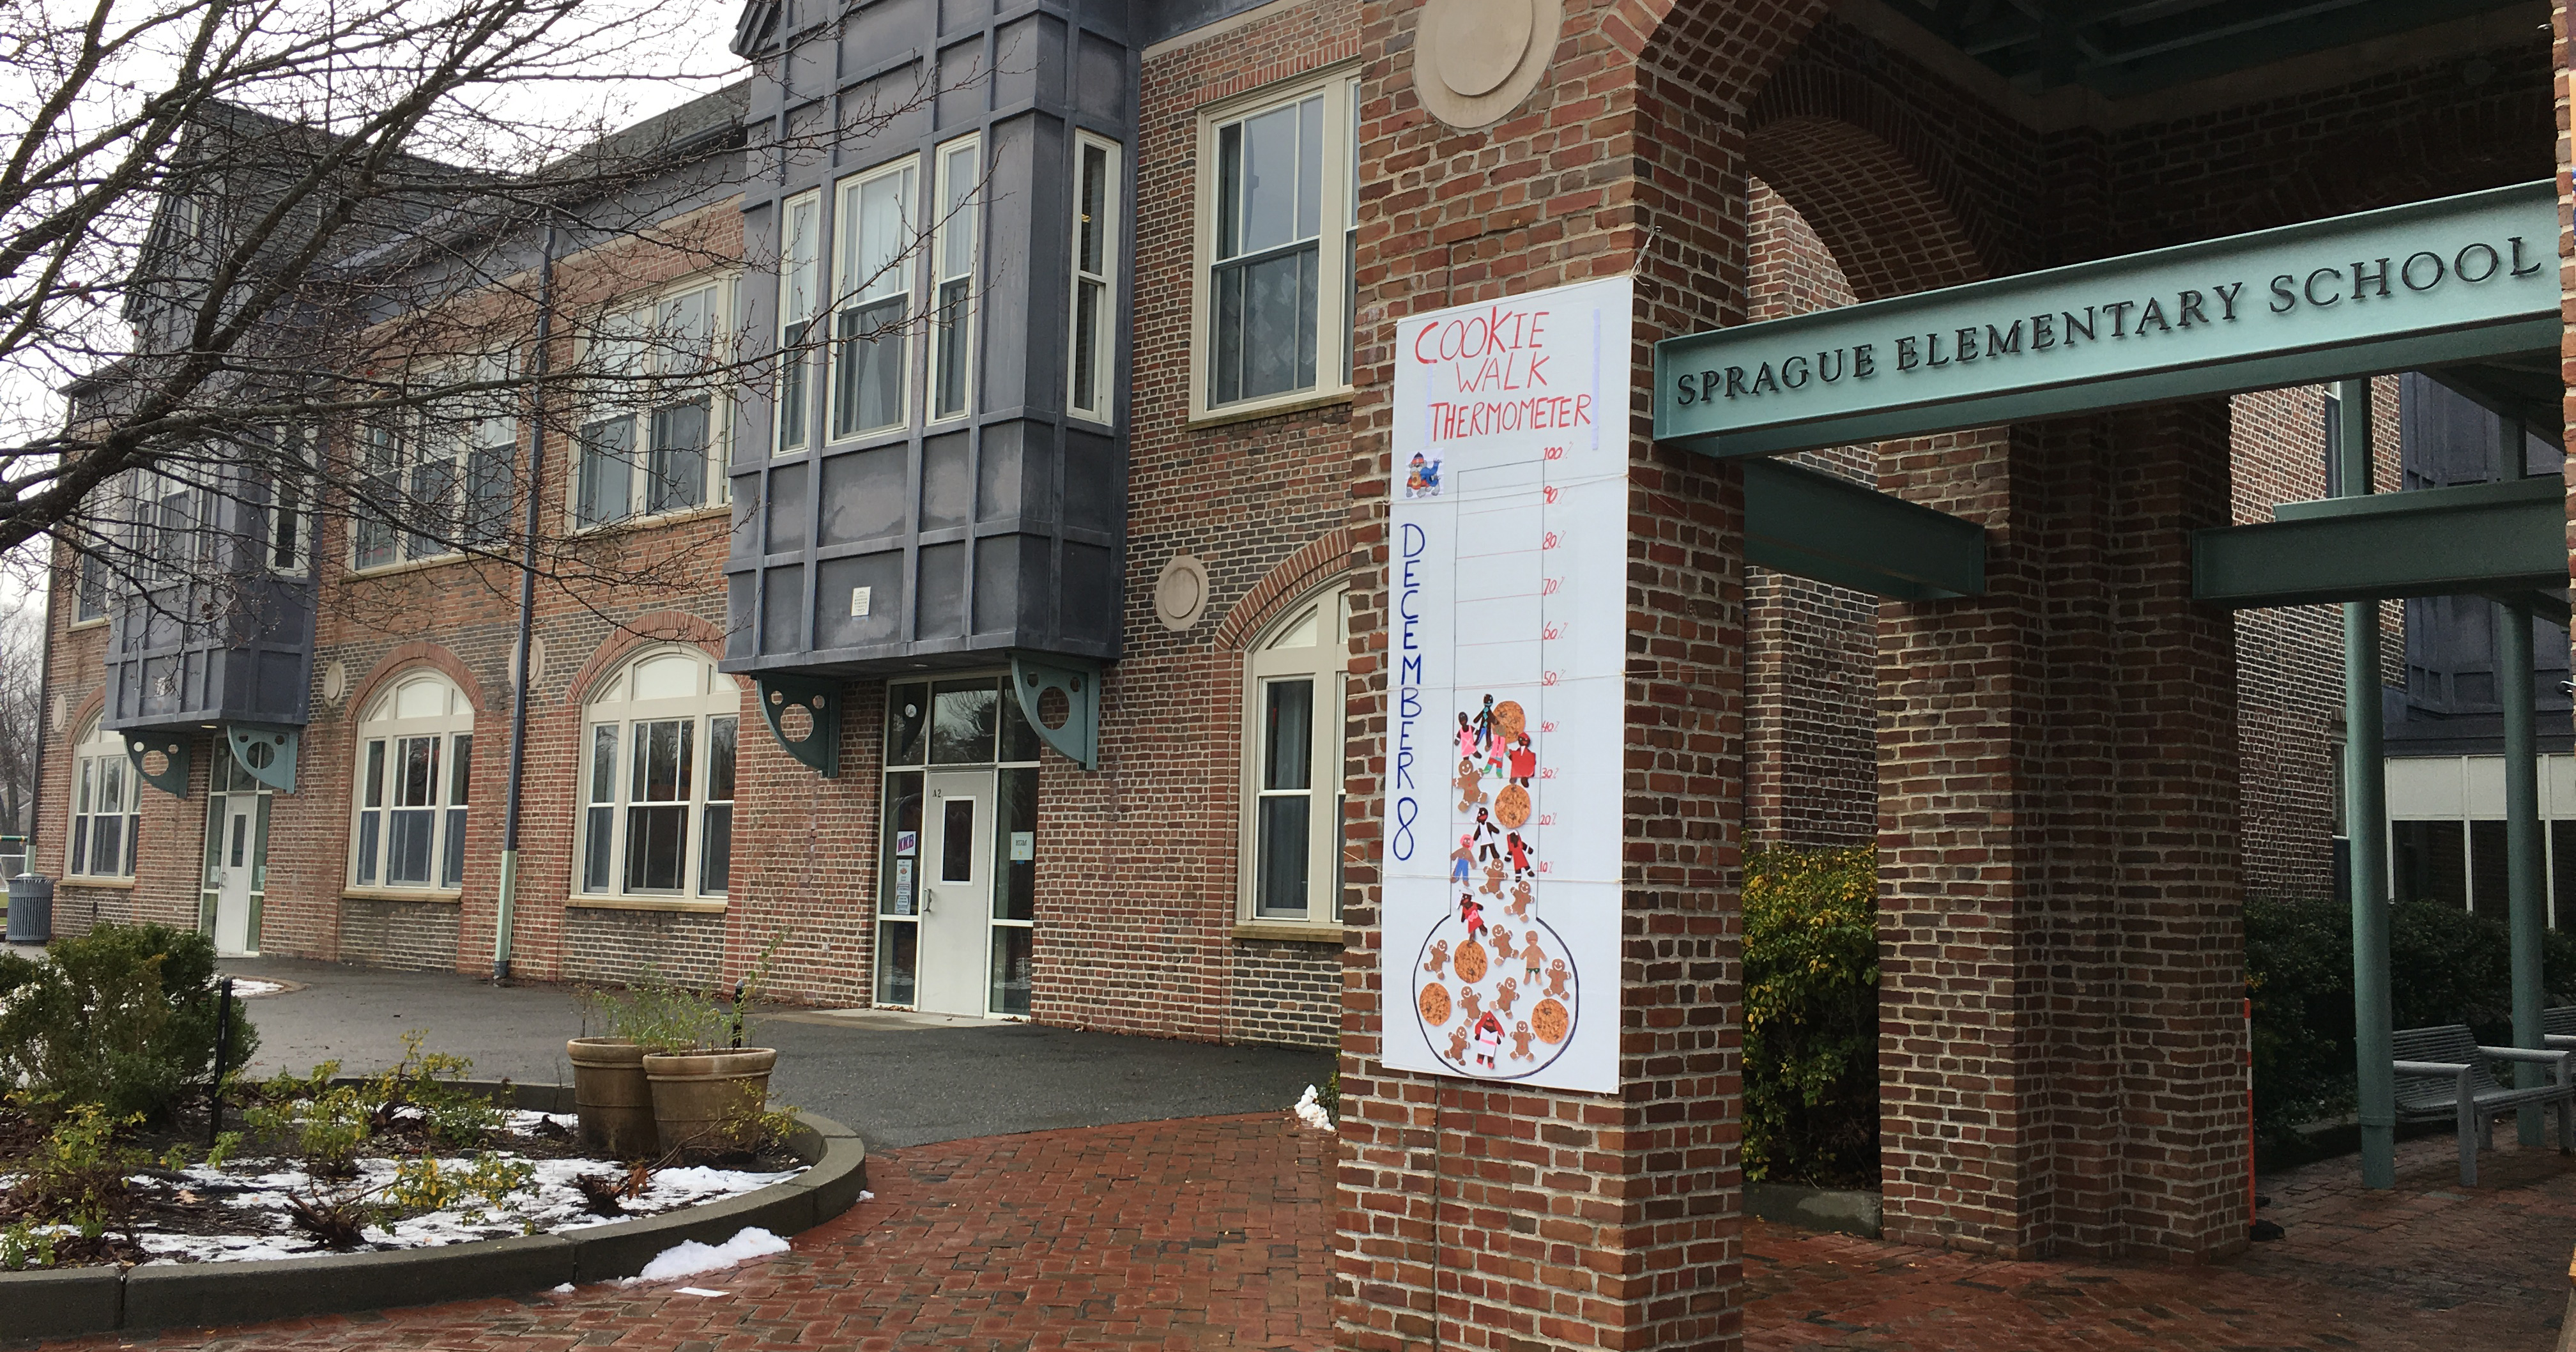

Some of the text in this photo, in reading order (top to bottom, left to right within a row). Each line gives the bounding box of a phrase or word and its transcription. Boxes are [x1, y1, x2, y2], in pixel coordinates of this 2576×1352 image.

[1414, 305, 1550, 364] COOKIE
[1677, 236, 2542, 405] SPRAGUE ELEMENTARY SCHOOL
[1455, 351, 1551, 393] WALK
[1428, 394, 1591, 442] THERMOMETER
[1393, 523, 1425, 861] DECEMBER 8
[932, 788, 942, 798] A2
[898, 834, 914, 853] KKB
